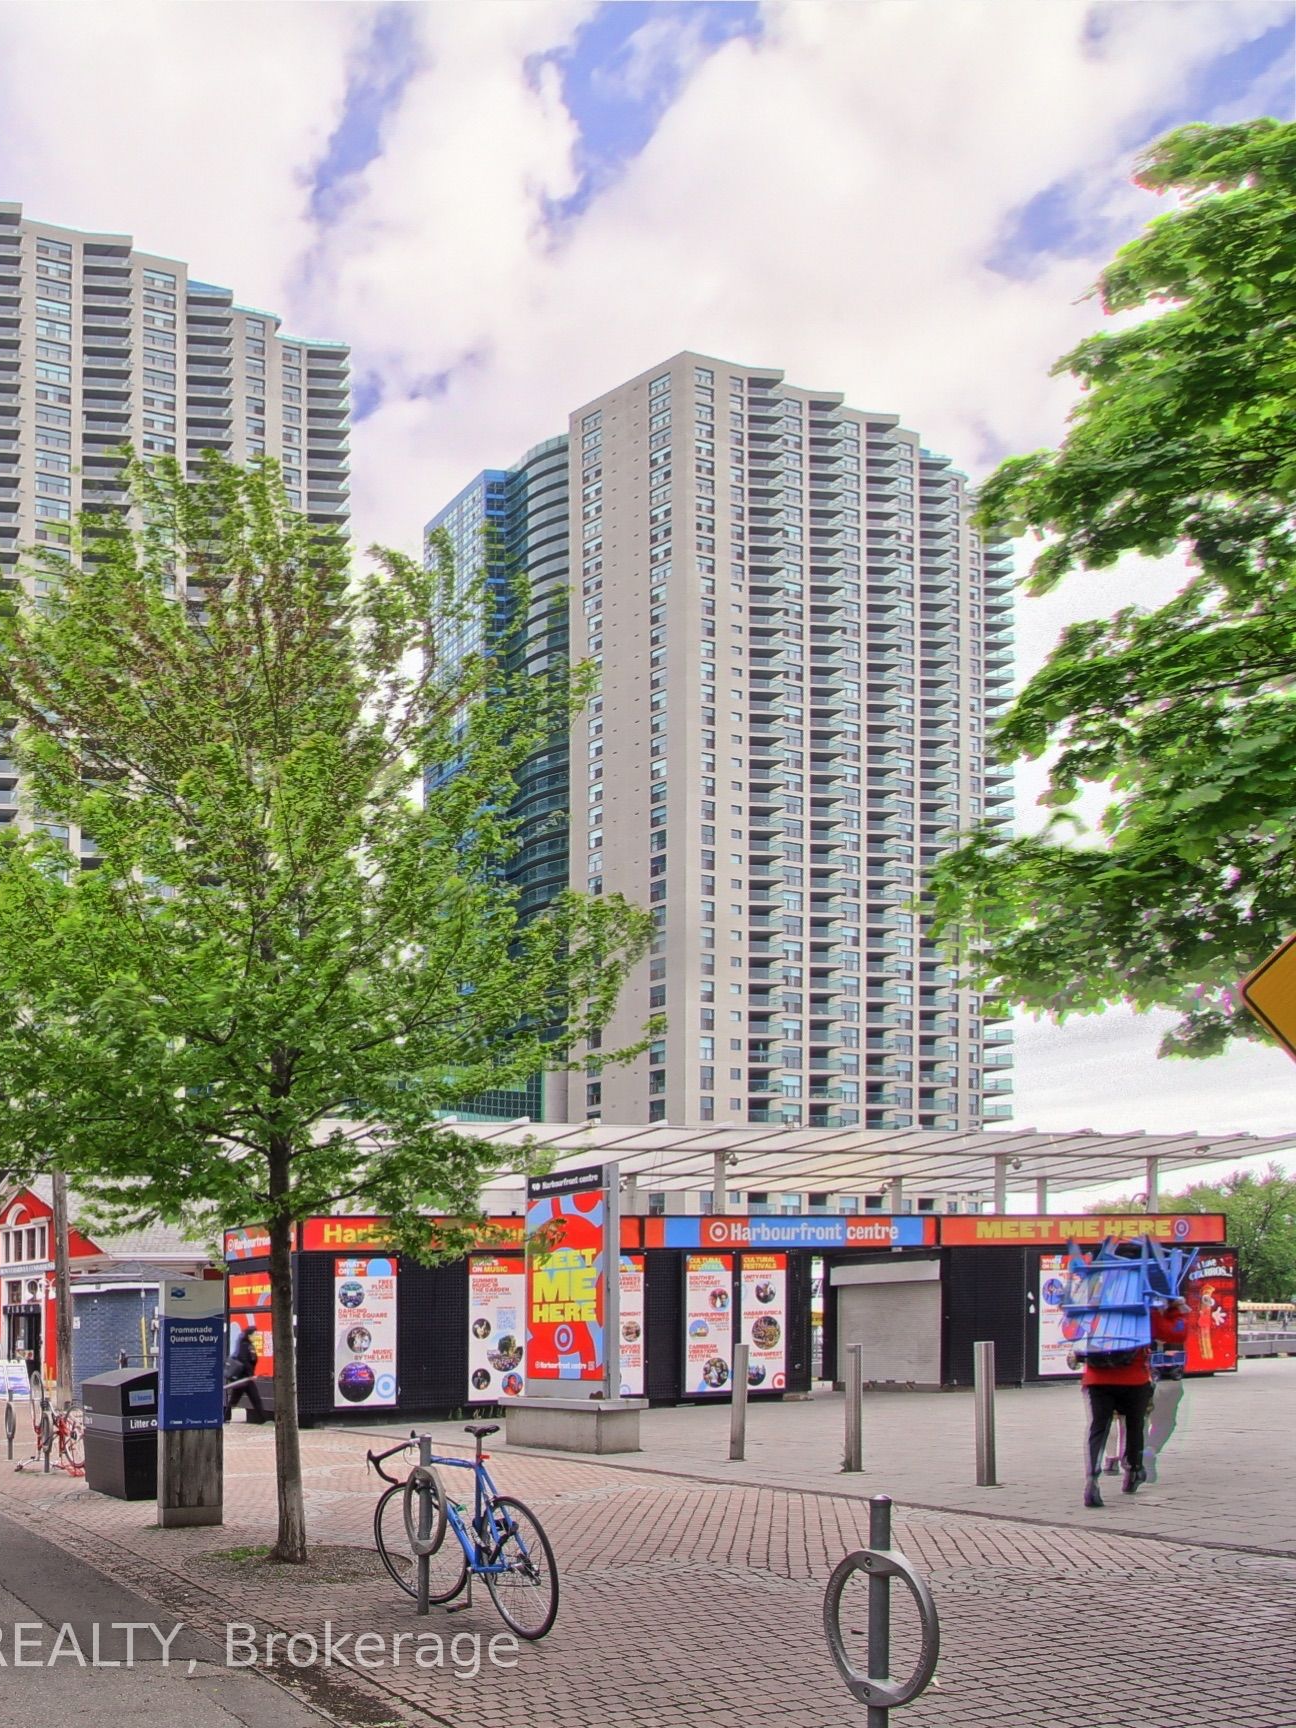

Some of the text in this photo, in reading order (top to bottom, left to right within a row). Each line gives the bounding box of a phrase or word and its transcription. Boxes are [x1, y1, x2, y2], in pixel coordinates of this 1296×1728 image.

[542, 1173, 599, 1190] Harbourfront centre
[730, 1222, 899, 1241] Harbourfront centre
[976, 1219, 1171, 1239] MEET ME HERE
[533, 1248, 597, 1271] MEET
[533, 1267, 597, 1302] ME
[533, 1301, 597, 1323] HERE
[170, 1334, 218, 1344] Queens Quay
[130, 1419, 149, 1429] Litter
